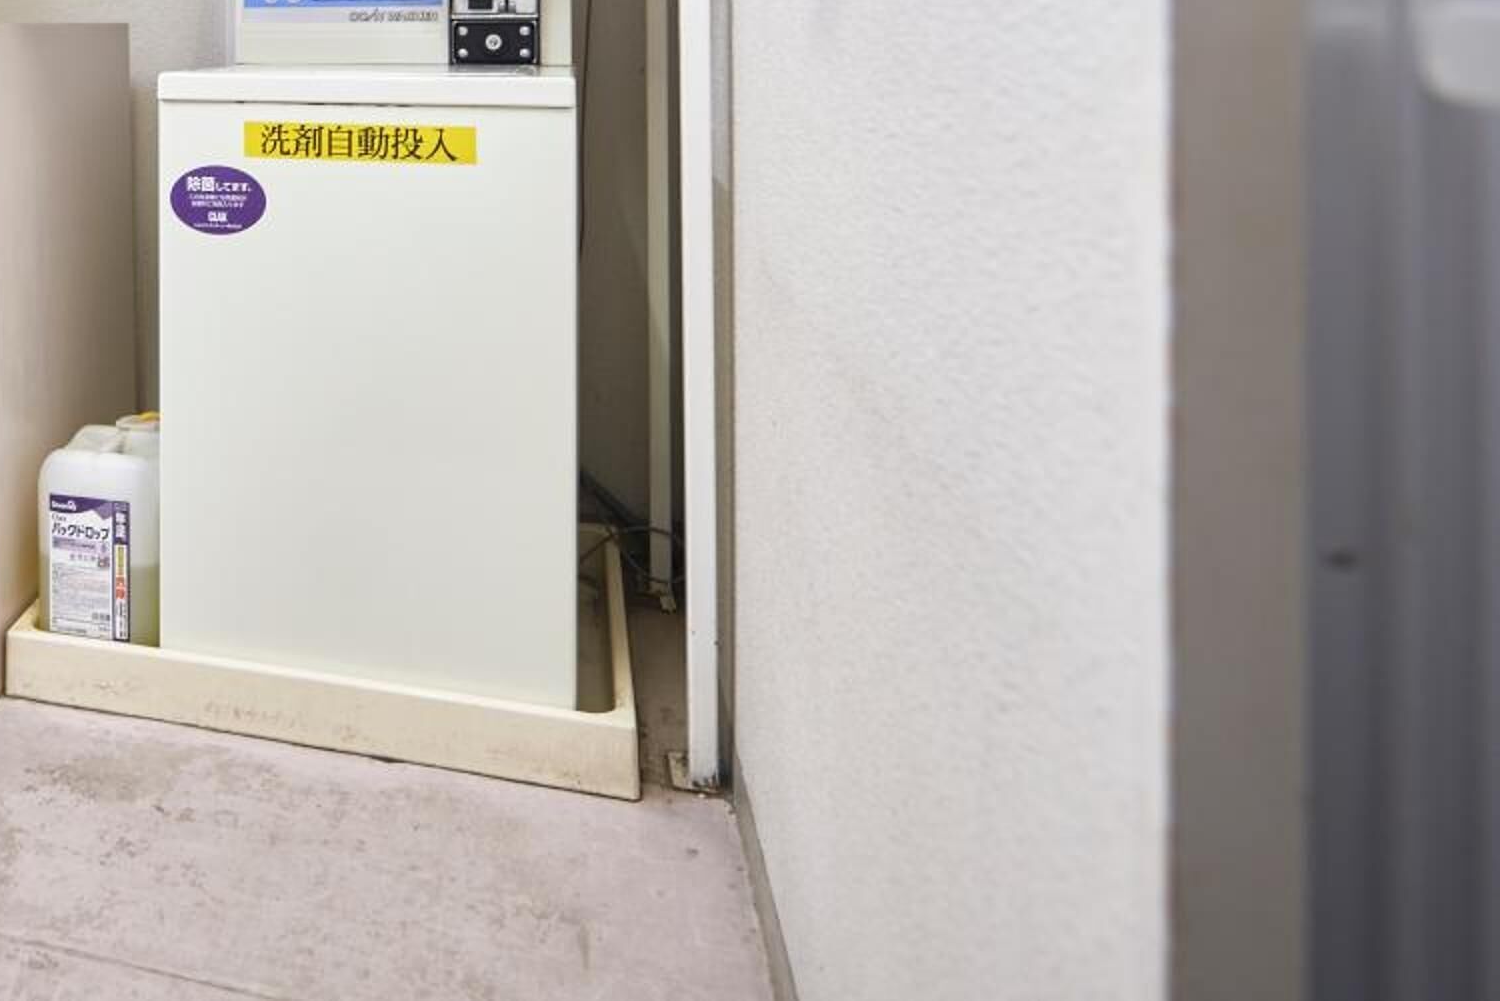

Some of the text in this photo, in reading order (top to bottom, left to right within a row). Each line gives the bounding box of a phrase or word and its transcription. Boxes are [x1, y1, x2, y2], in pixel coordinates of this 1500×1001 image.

[260, 123, 458, 162] 洗剤自動投入
[51, 522, 109, 541] バックドロップ
